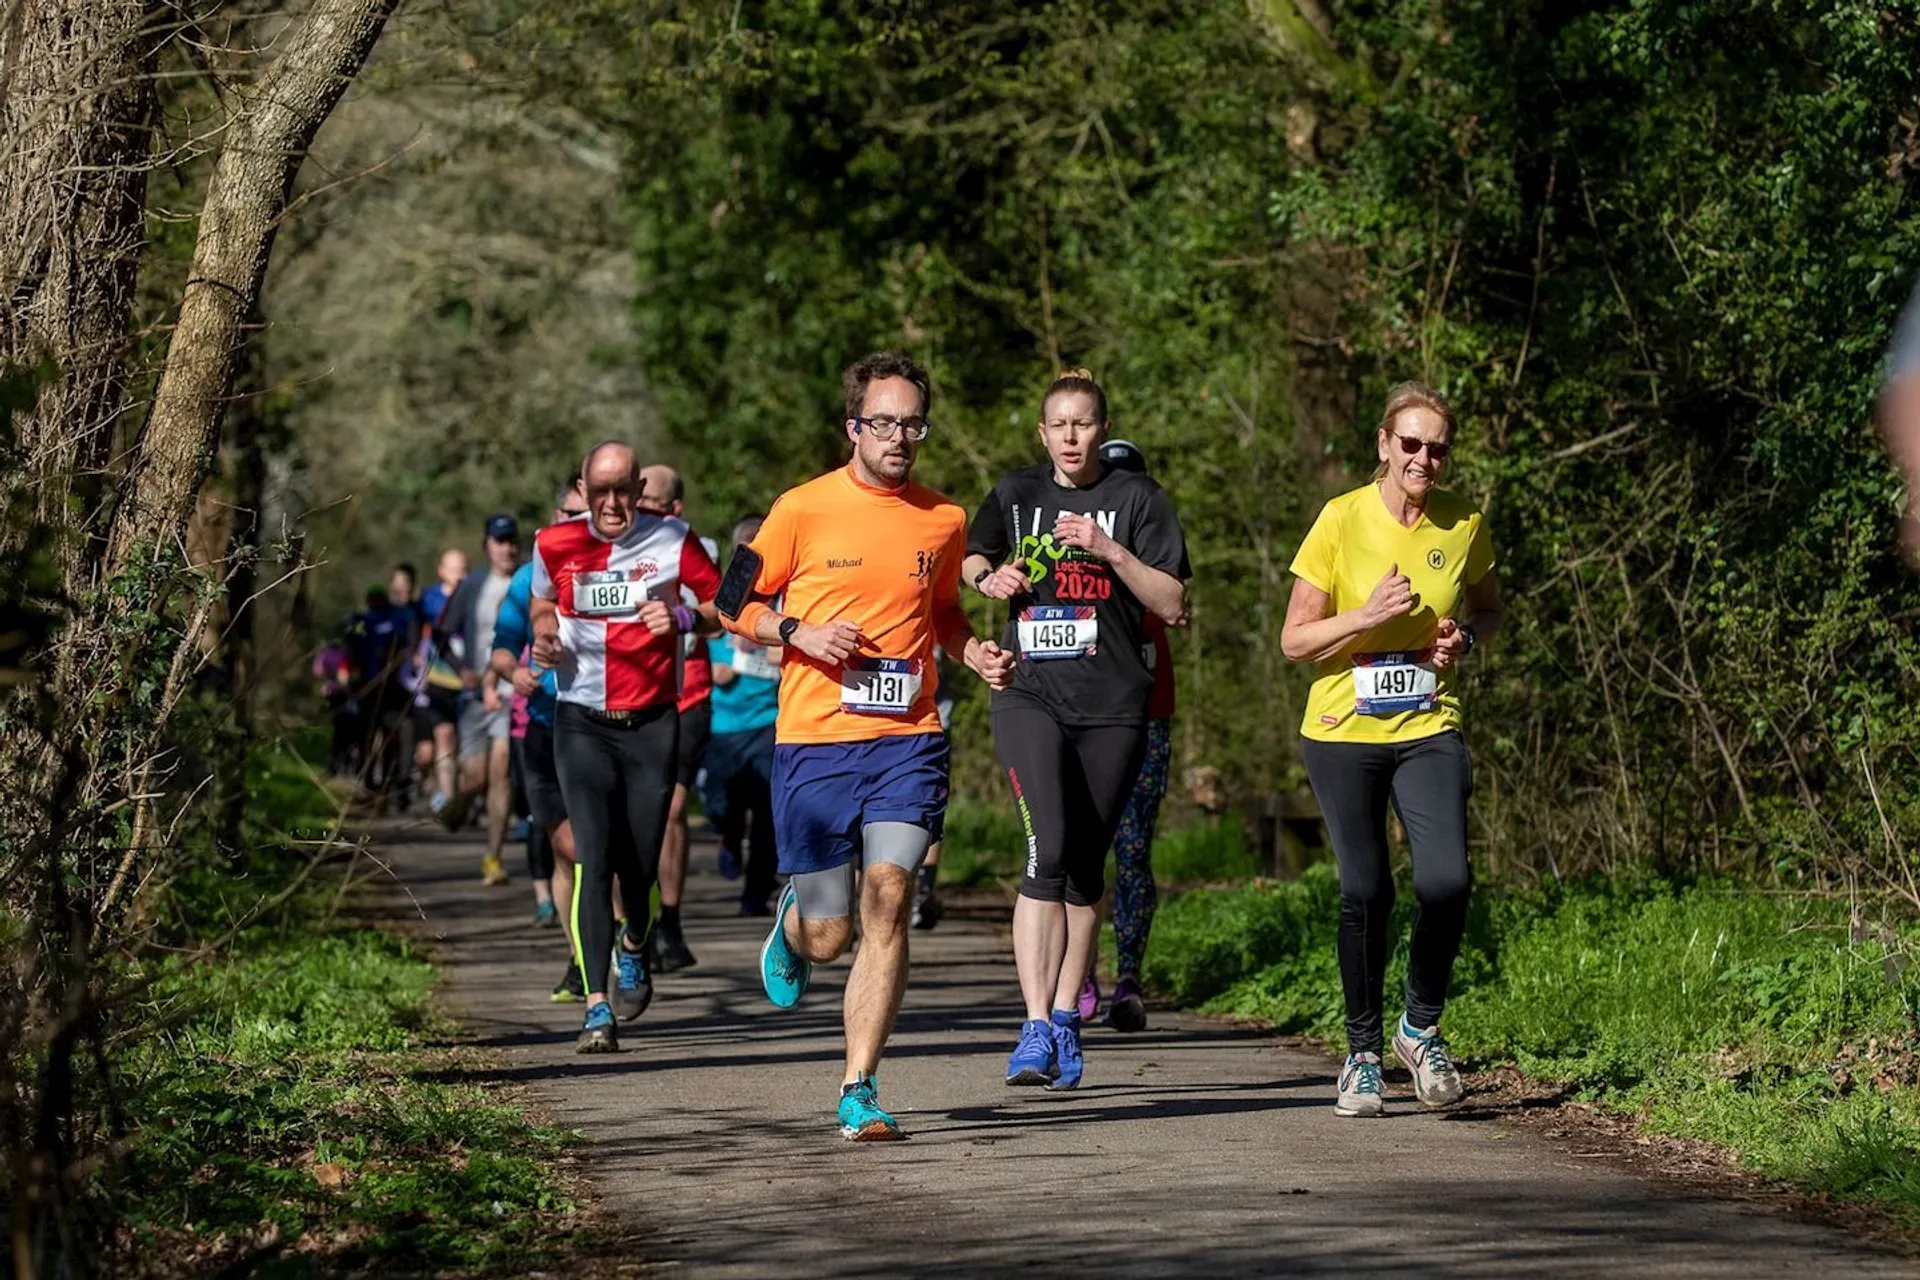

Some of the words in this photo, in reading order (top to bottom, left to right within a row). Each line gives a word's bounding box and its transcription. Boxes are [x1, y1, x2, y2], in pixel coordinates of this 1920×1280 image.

[826, 558, 863, 569] Michael
[592, 585, 628, 607] 1887
[1054, 572, 1111, 600] 2020
[1045, 609, 1064, 619] ATW
[1033, 624, 1077, 648] 1458
[1385, 653, 1404, 664] ATW
[867, 676, 903, 702] 1131
[1374, 669, 1416, 695] 1497
